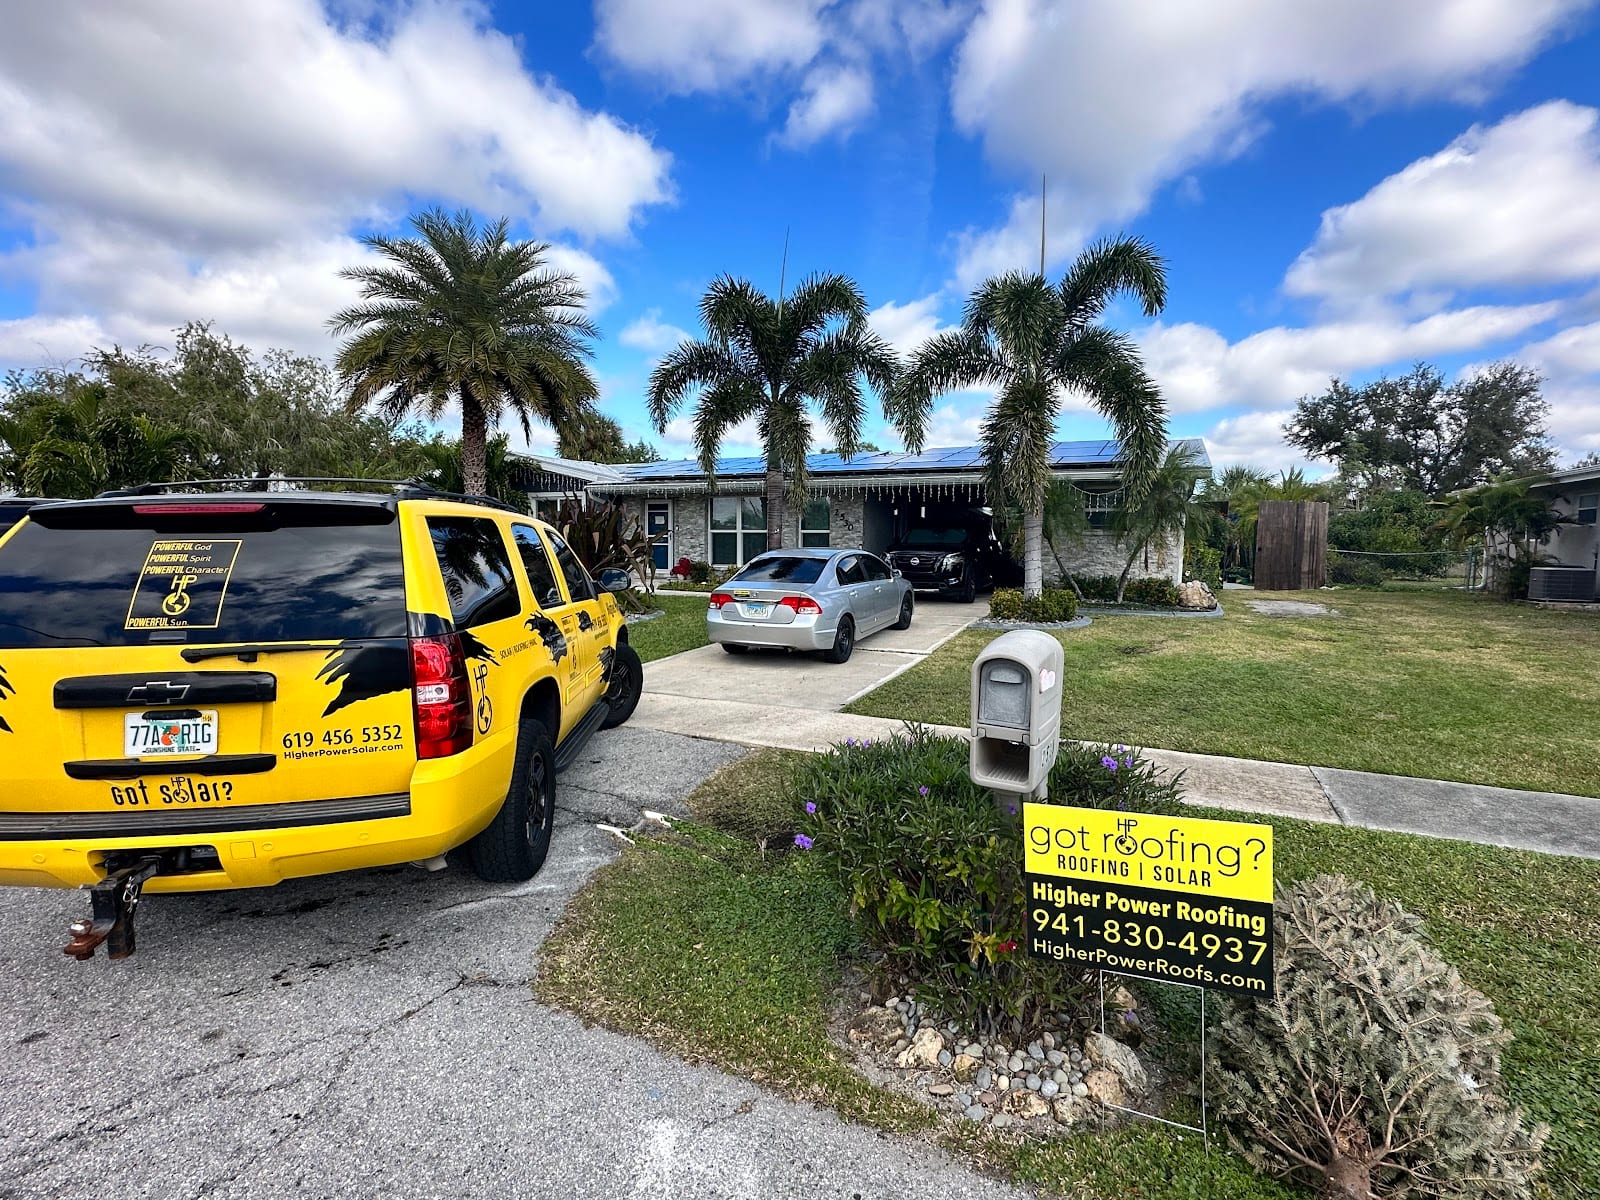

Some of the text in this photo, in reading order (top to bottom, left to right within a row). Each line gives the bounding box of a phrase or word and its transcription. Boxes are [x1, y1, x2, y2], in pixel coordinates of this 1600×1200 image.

[149, 554, 211, 563] POWERFUL Spirit
[154, 543, 193, 551] POWERFUL
[144, 565, 229, 574] POWERFUL Character
[128, 618, 169, 627] POWERFUL
[130, 723, 212, 746] 77A RIG
[282, 724, 403, 749] 619 456 5352
[283, 743, 404, 760] HigherPowerSolar.com
[1030, 825, 1090, 855] got
[1057, 854, 1129, 877] ROOFING
[1153, 865, 1212, 888] SOLAR
[1032, 881, 1266, 937] Higher Power Roofing
[1032, 908, 1268, 966] 941-830-4937
[1033, 938, 1267, 992] HigherPowerRoofs.com
